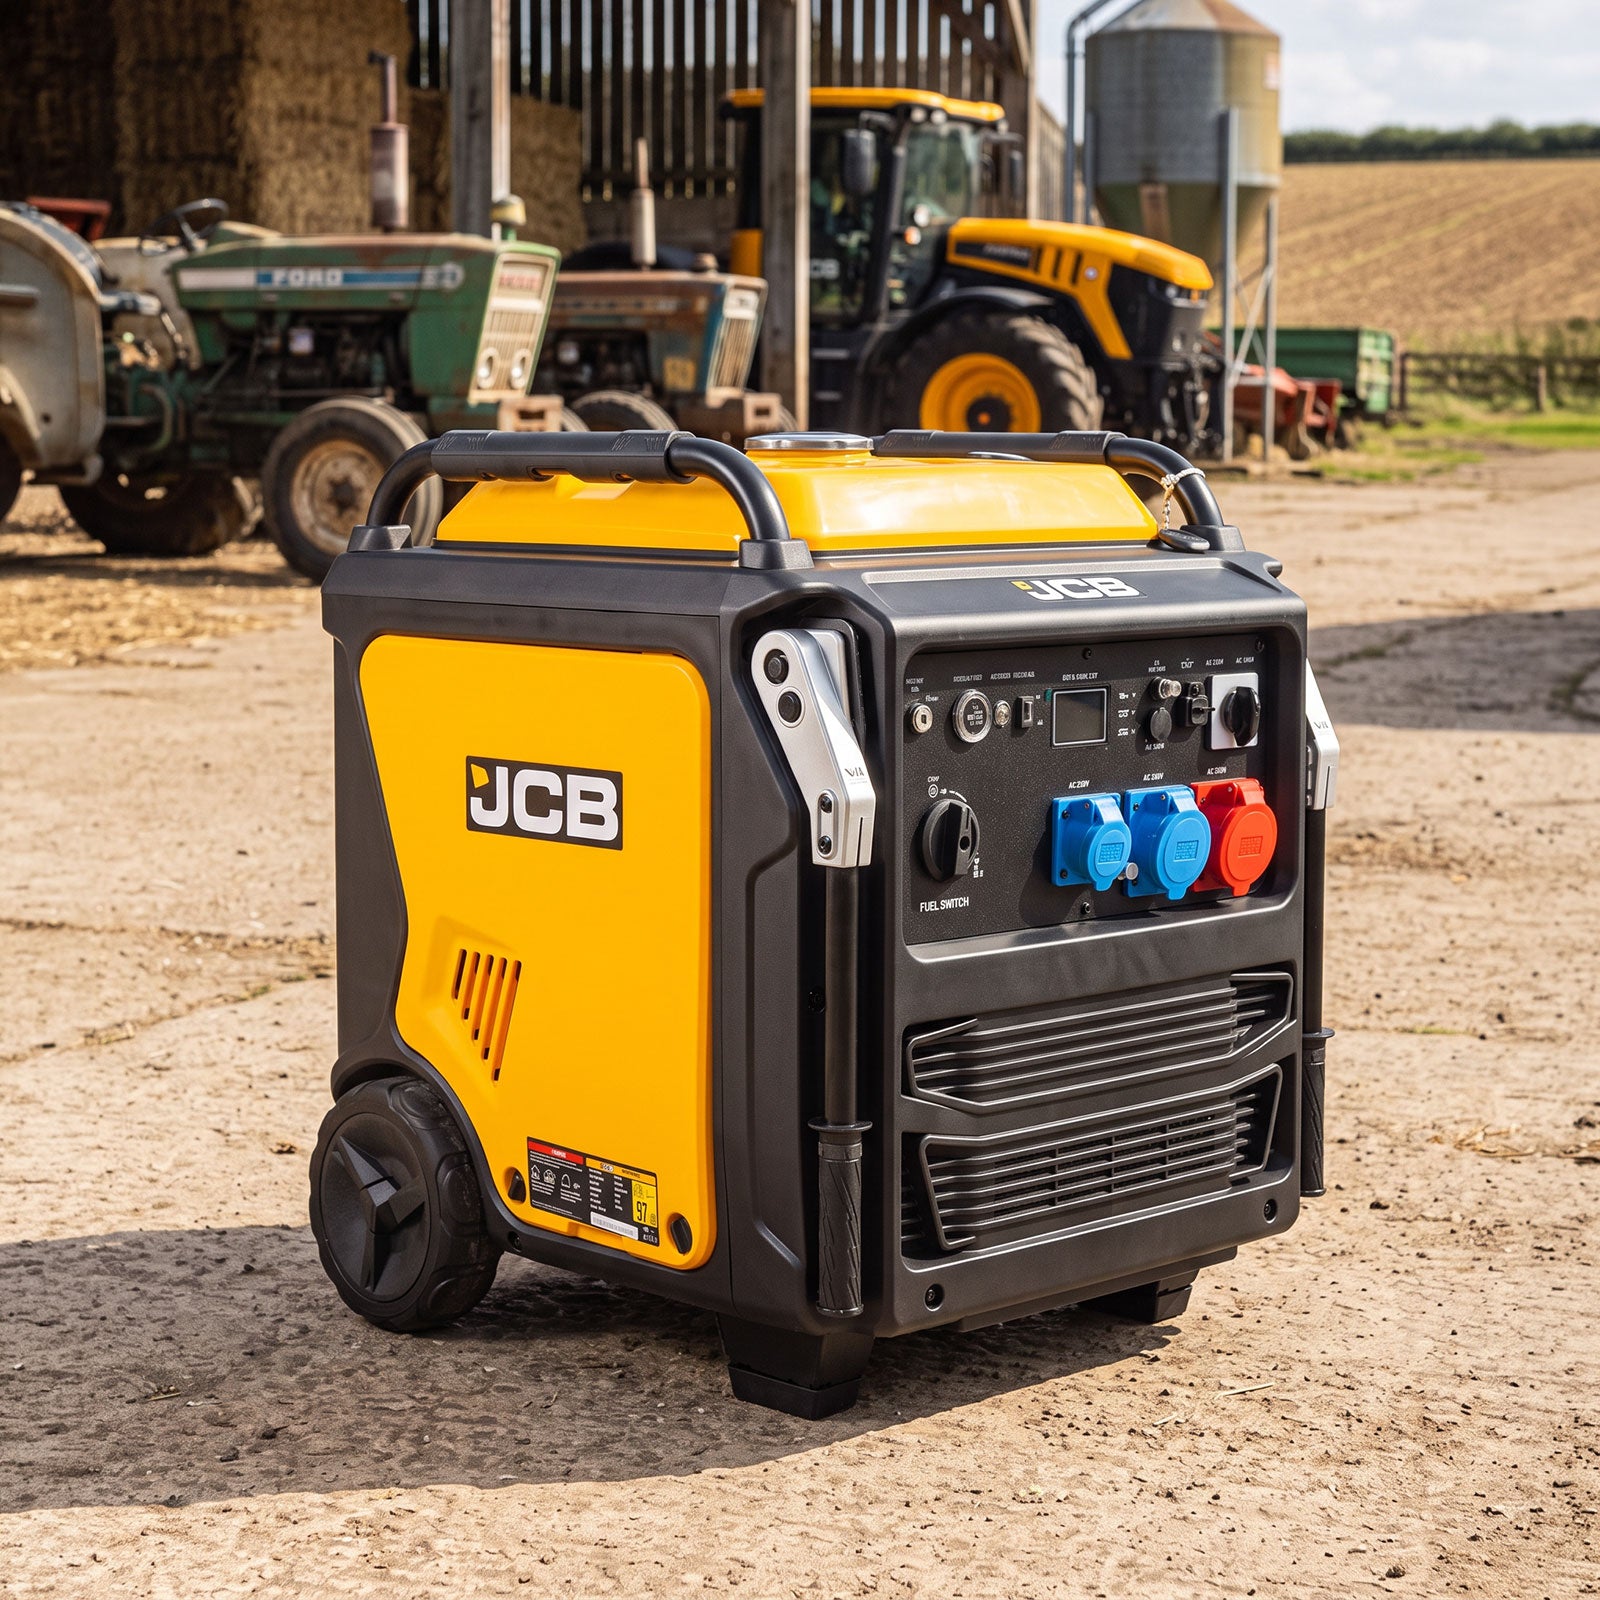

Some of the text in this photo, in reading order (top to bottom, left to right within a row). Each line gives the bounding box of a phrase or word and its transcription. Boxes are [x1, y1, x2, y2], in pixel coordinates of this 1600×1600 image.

[273, 268, 342, 289] FORD
[1011, 577, 1140, 601] JCB
[470, 764, 619, 842] JCB
[920, 897, 970, 912] FUEL SWITCH
[636, 1201, 648, 1223] 97
